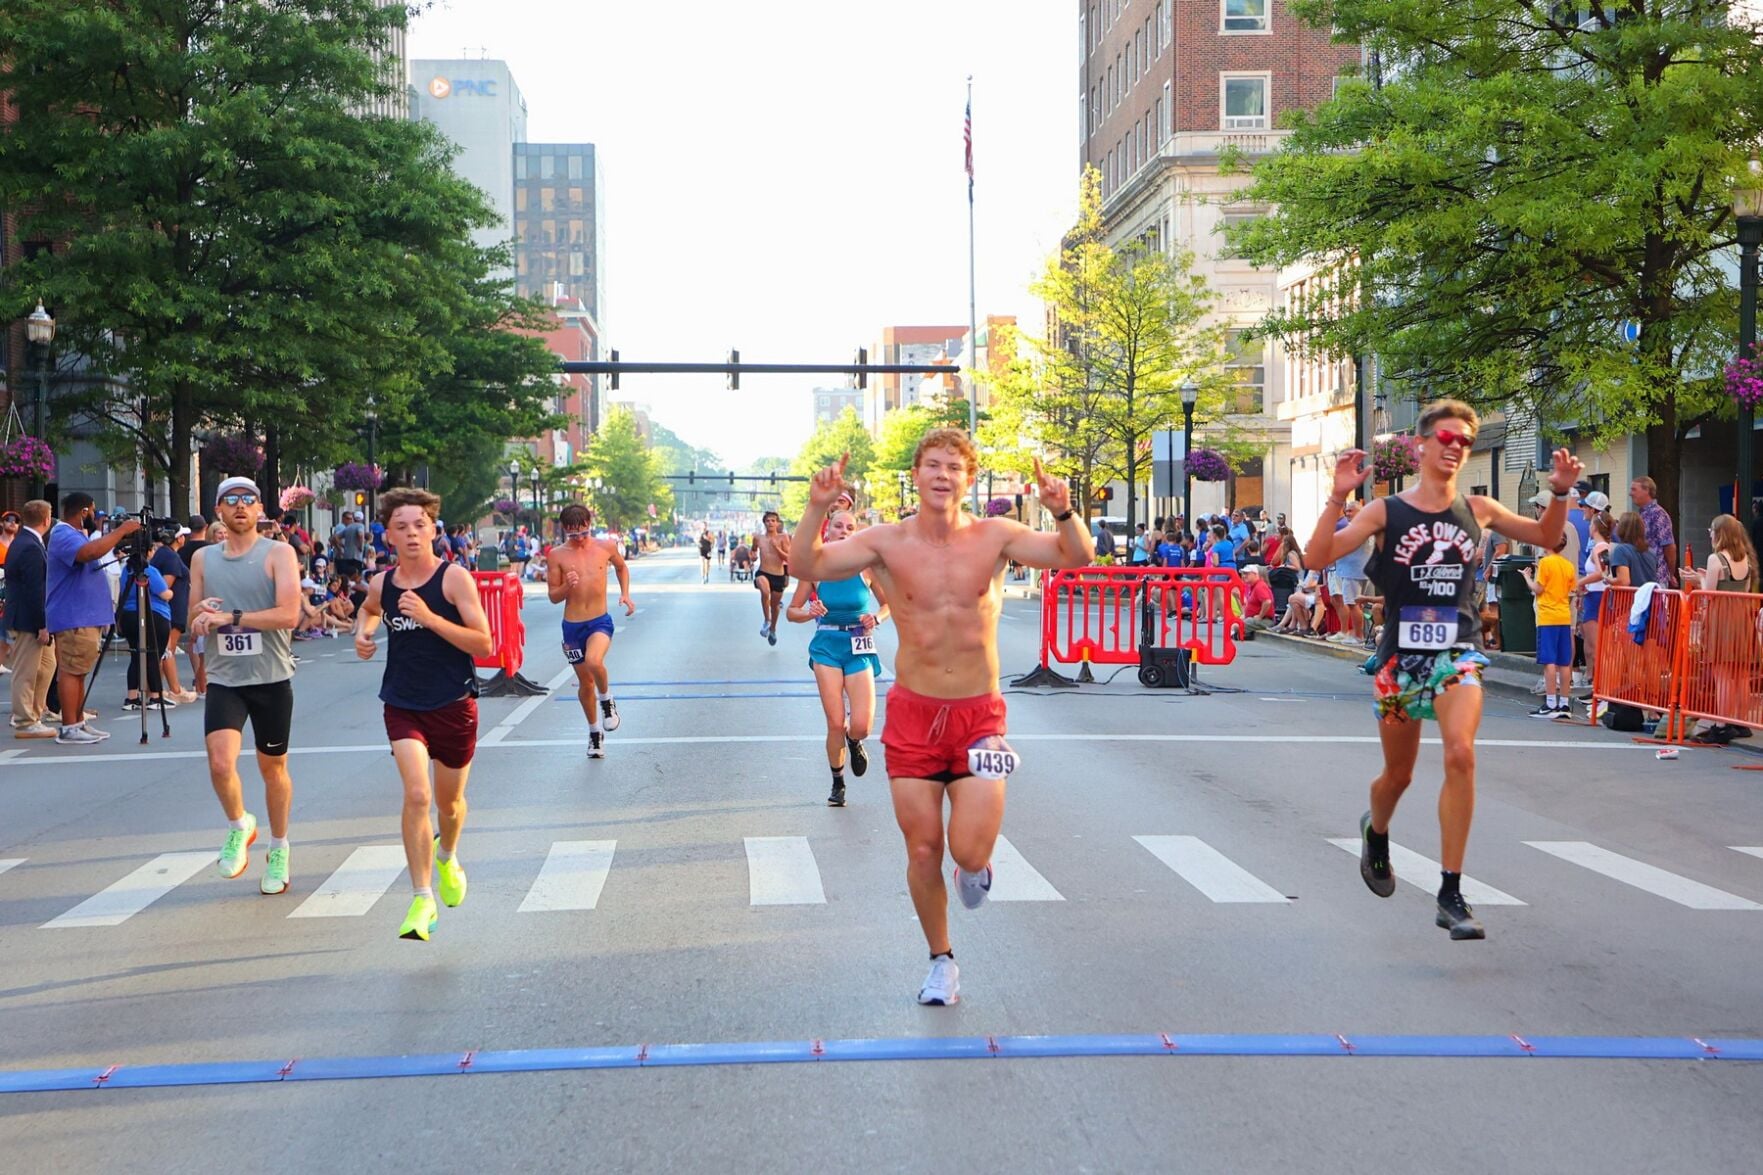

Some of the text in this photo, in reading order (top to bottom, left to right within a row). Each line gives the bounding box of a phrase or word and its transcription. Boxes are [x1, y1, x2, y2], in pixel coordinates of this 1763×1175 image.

[452, 79, 497, 97] PNC
[1393, 521, 1475, 566] JESSE OWENS
[224, 634, 253, 652] 361
[1409, 623, 1448, 644] 689
[855, 637, 874, 651] 216
[974, 751, 1015, 775] 1439
